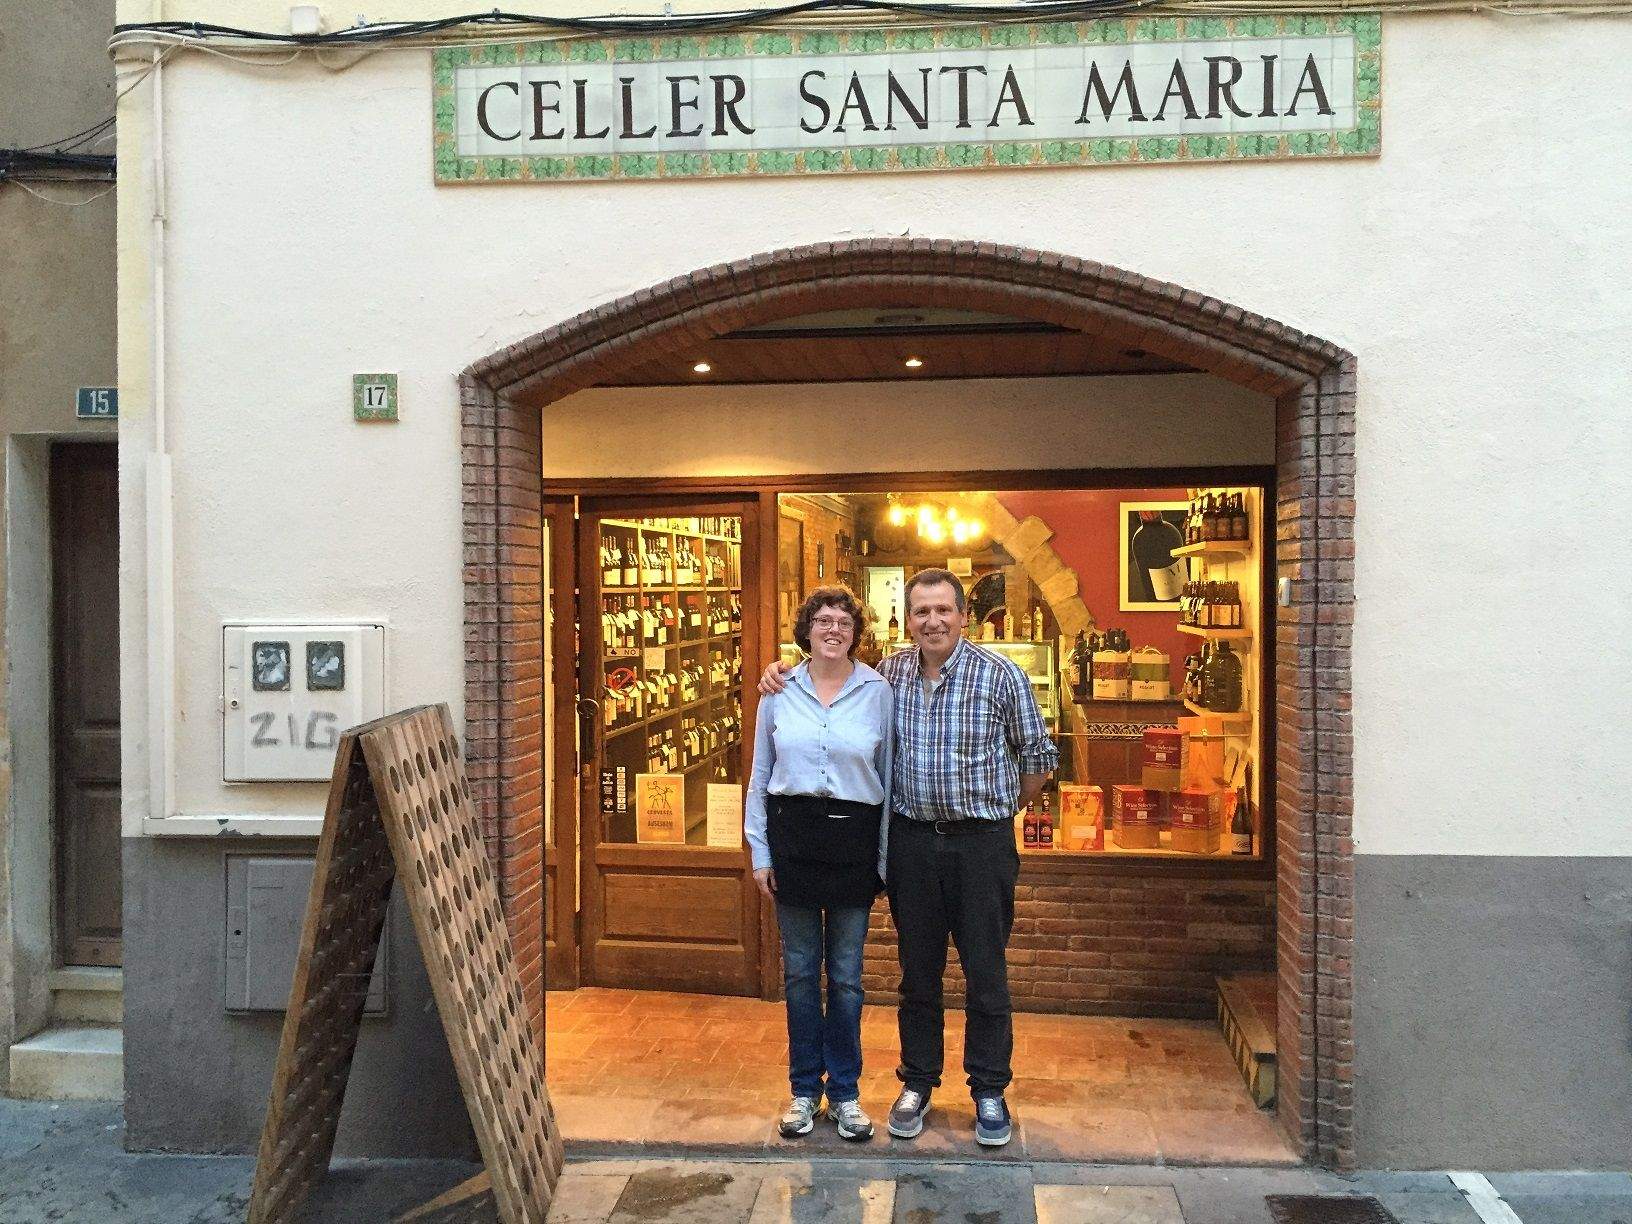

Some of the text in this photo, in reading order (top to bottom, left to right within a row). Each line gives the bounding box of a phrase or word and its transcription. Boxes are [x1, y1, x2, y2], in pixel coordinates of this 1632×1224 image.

[476, 52, 1336, 141] CELLER SANTA MARIA
[90, 390, 109, 413] 15
[366, 386, 386, 406] 17
